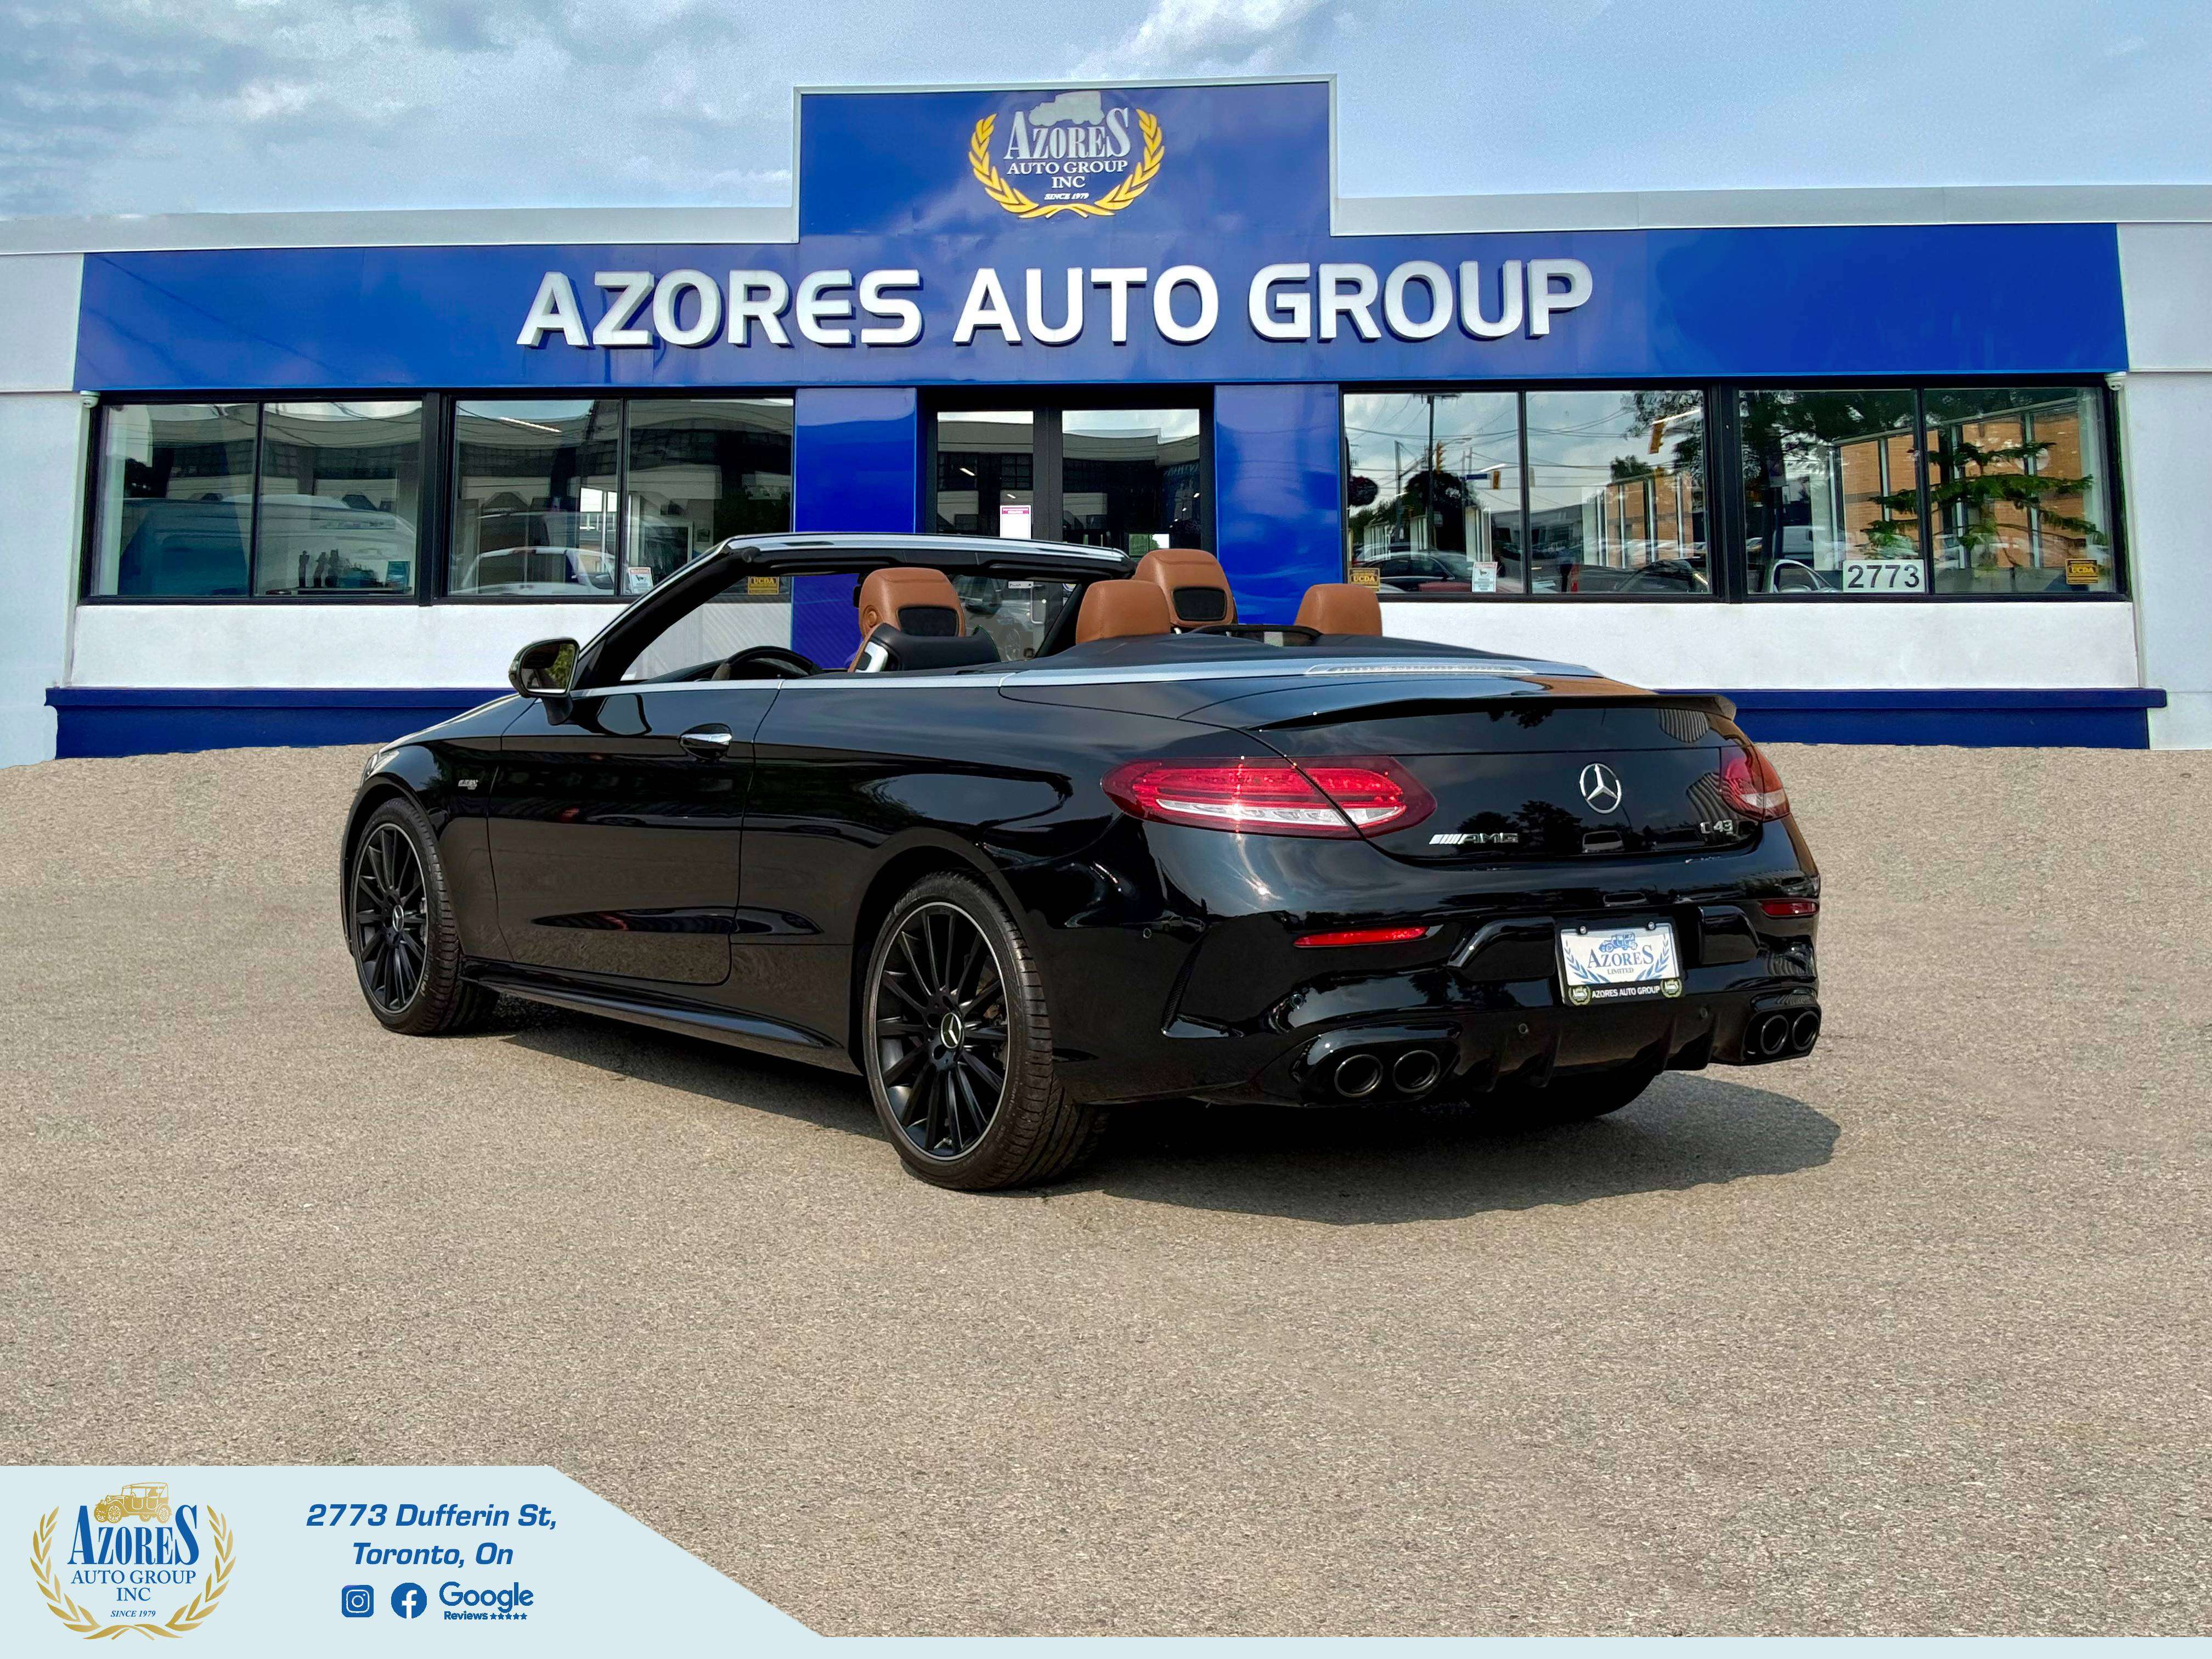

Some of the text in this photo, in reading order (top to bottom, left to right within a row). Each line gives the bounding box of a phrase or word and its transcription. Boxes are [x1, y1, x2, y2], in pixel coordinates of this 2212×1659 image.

[1003, 107, 1131, 160] AZORES
[1007, 160, 1128, 176] AUTO GROUP
[1052, 176, 1086, 188] INC
[517, 260, 1593, 348] AZORES AUTO GROUP
[1848, 564, 1920, 588] 2773
[1713, 820, 1733, 833] 43
[1587, 945, 1654, 968] AZORES
[1592, 989, 1618, 998] AZORES
[1619, 988, 1636, 996] AUTO
[1637, 985, 1660, 995] GROUP
